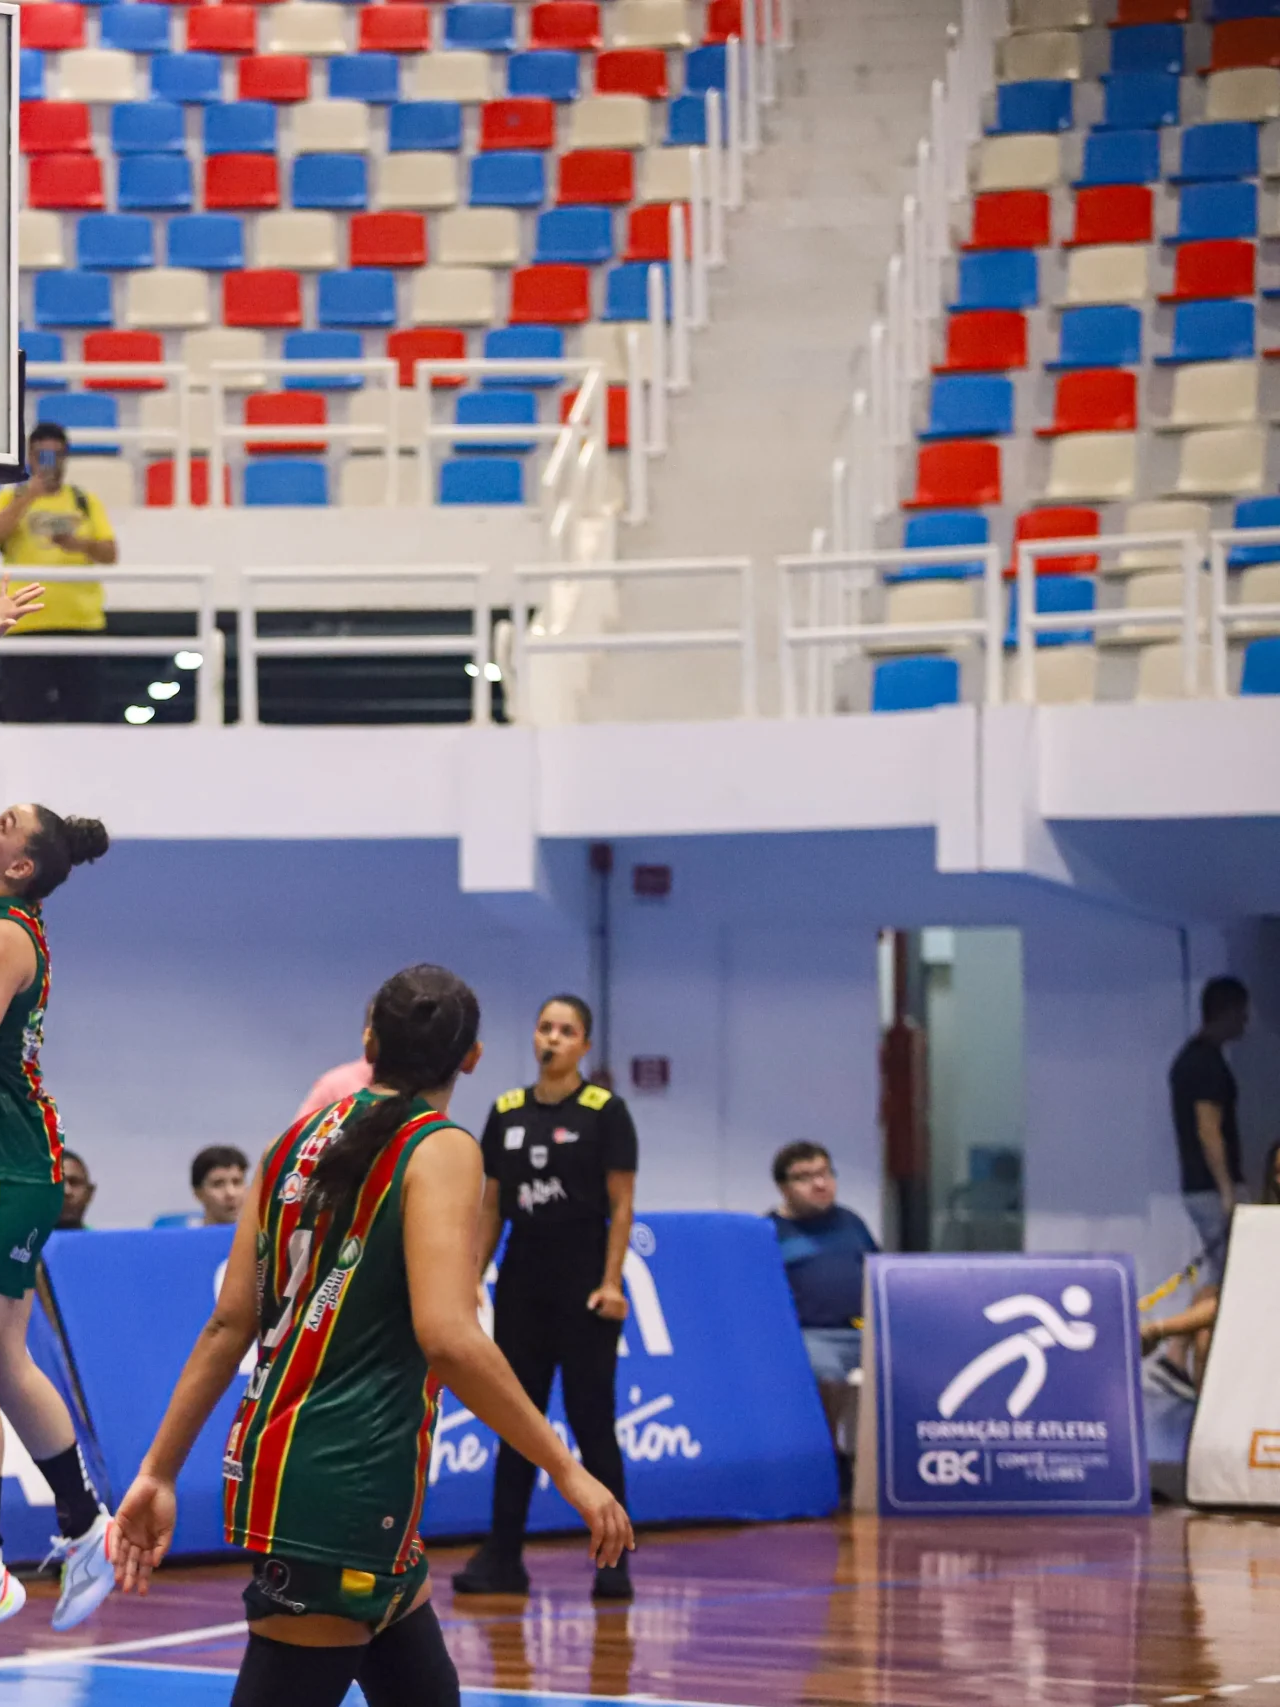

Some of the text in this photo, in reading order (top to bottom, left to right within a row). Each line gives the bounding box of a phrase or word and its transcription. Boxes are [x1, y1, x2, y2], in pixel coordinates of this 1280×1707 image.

[1013, 1420, 1035, 1440] DE
[1036, 1420, 1108, 1441] ATLETAS
[918, 1450, 981, 1486] CBC
